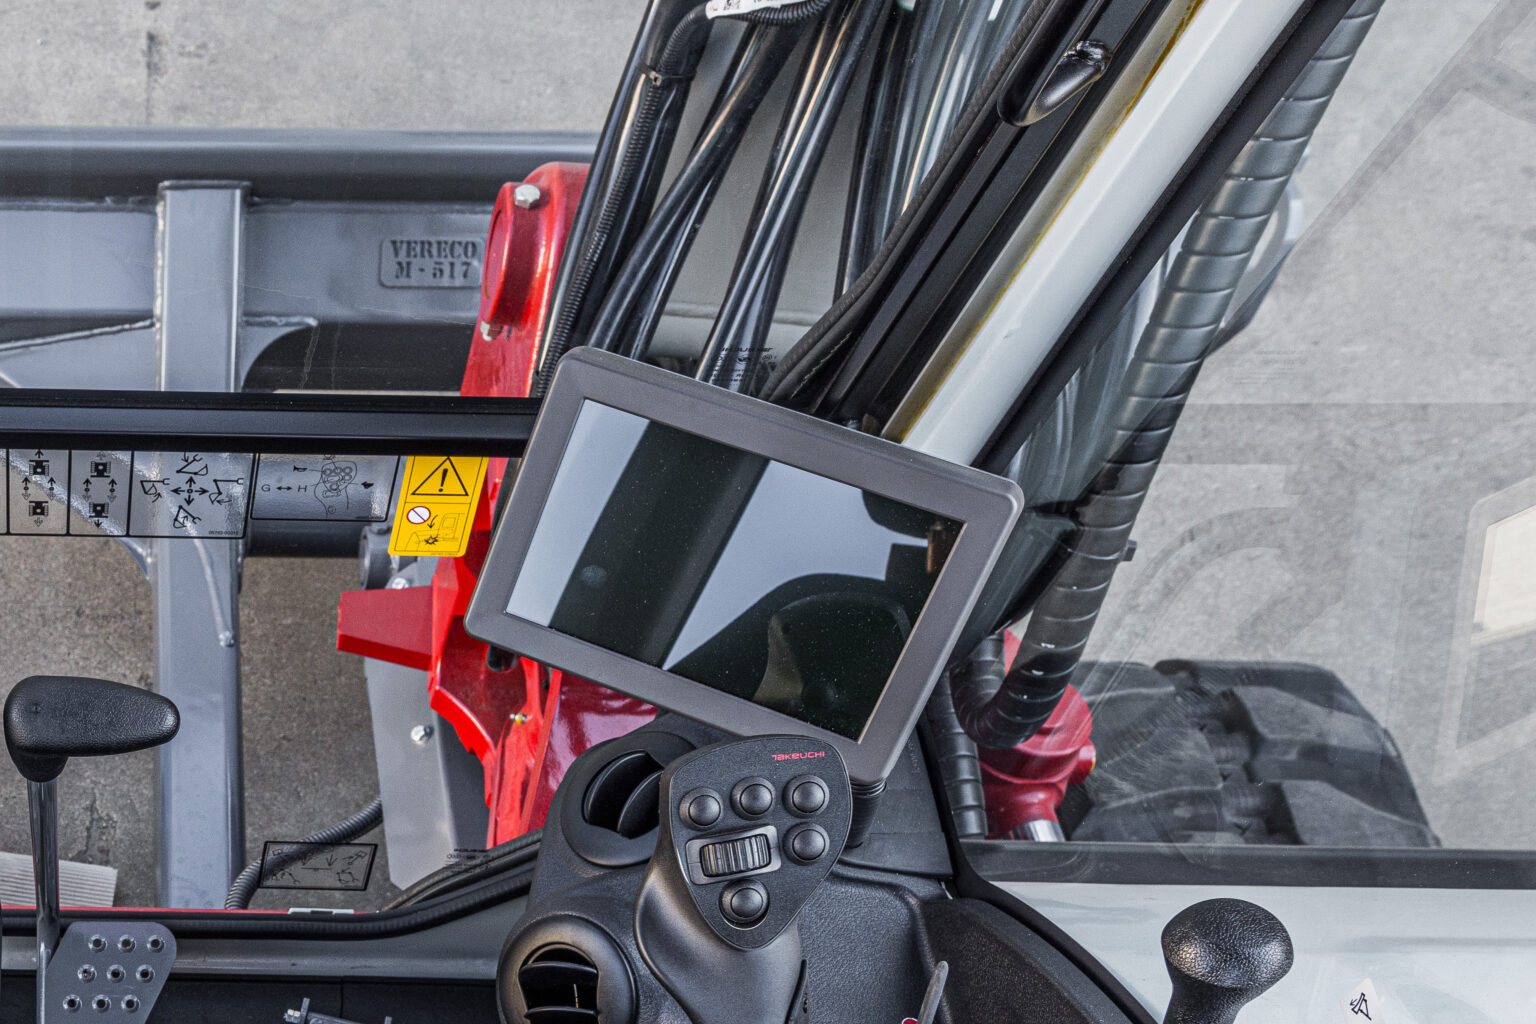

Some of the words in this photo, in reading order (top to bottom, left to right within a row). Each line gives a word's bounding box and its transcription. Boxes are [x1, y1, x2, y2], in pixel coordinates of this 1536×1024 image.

[390, 239, 478, 259] VERECO
[261, 484, 271, 493] G
[297, 485, 307, 493] H
[771, 751, 825, 761] TAKEUCHI
